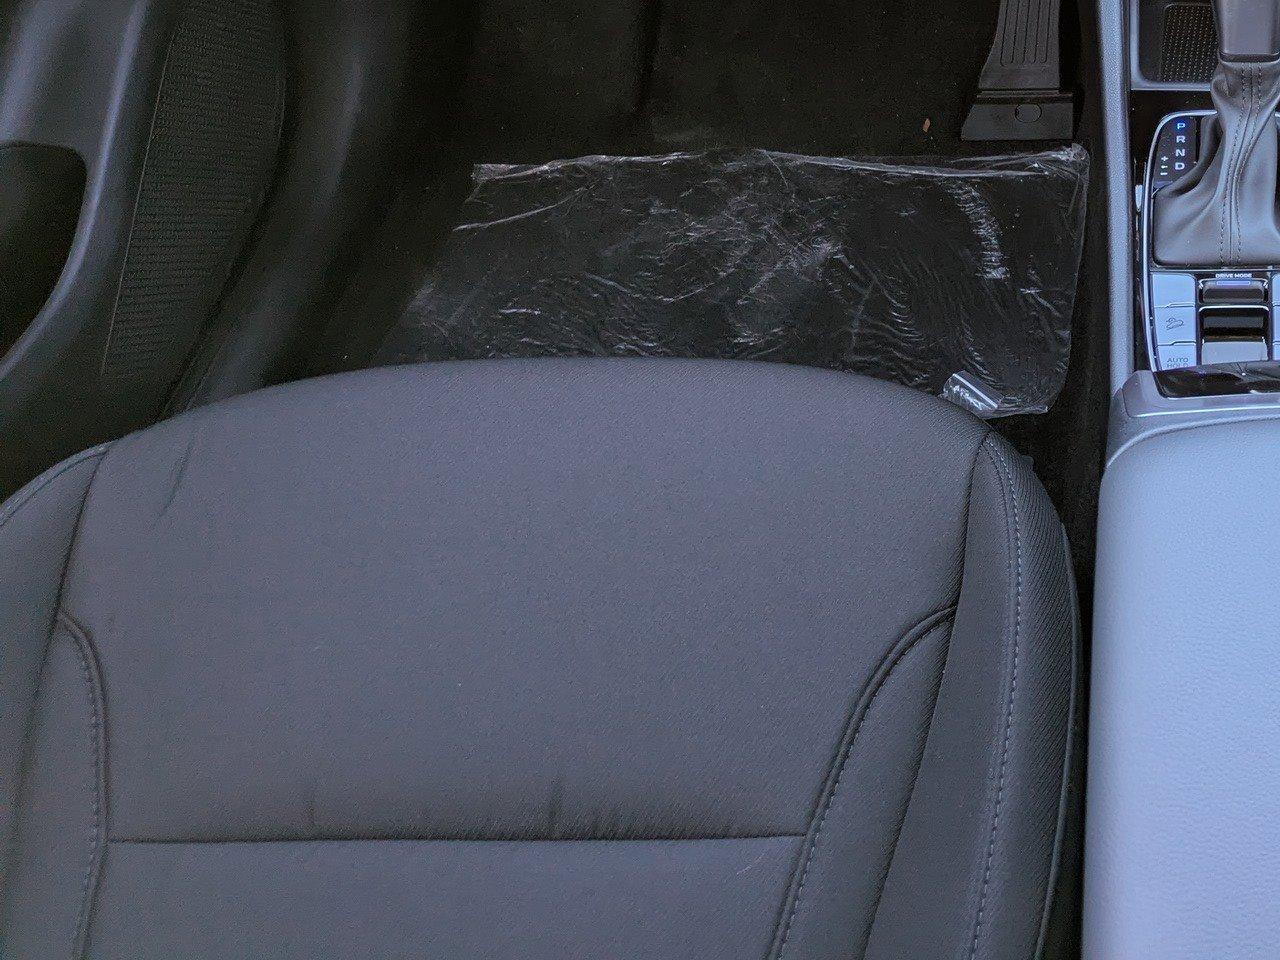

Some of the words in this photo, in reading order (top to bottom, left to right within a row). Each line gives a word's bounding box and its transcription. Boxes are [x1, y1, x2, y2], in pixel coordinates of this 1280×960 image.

[1177, 122, 1186, 130] P
[1176, 135, 1186, 143] R
[1175, 149, 1186, 157] N
[1174, 162, 1186, 170] D
